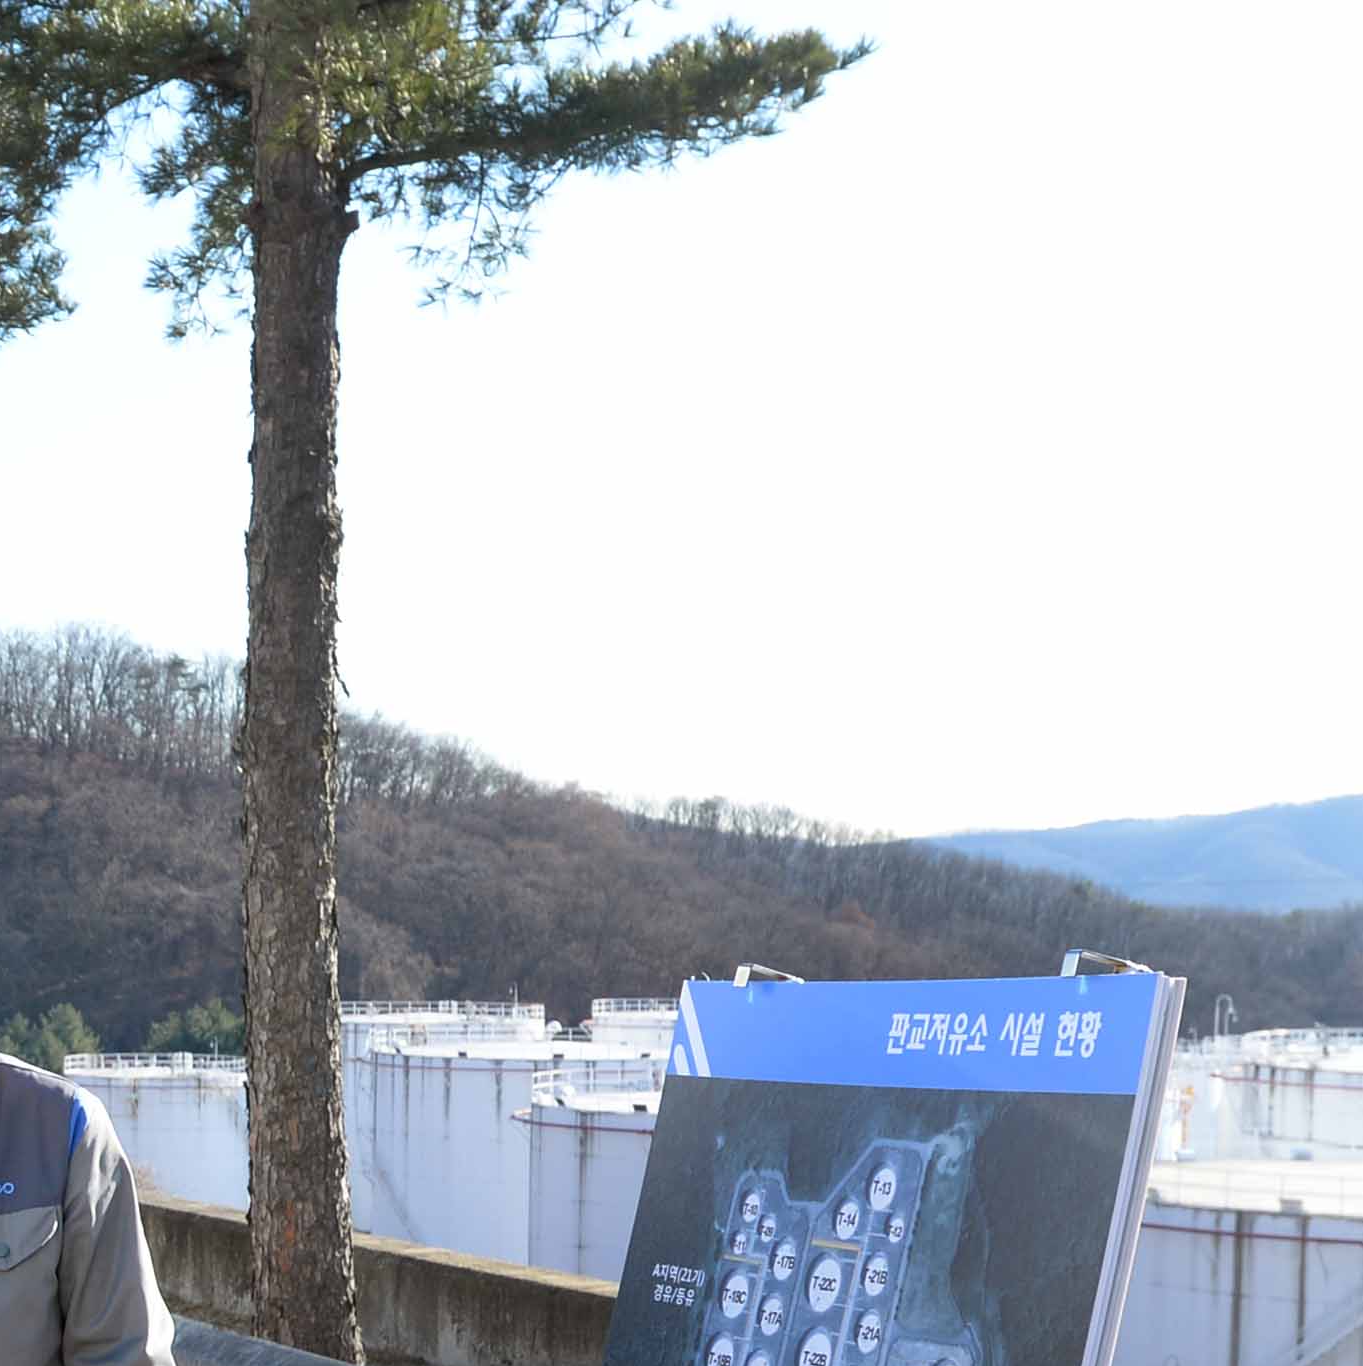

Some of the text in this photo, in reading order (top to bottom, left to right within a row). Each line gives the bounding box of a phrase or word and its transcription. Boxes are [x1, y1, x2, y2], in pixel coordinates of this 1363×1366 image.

[886, 1010, 1102, 1059] 판교저유소 시설 현황
[873, 1181, 892, 1196] T-13
[652, 1263, 706, 1287] A지역(21기)
[812, 1276, 837, 1292] T-22C
[654, 1284, 695, 1307] 경유/등유
